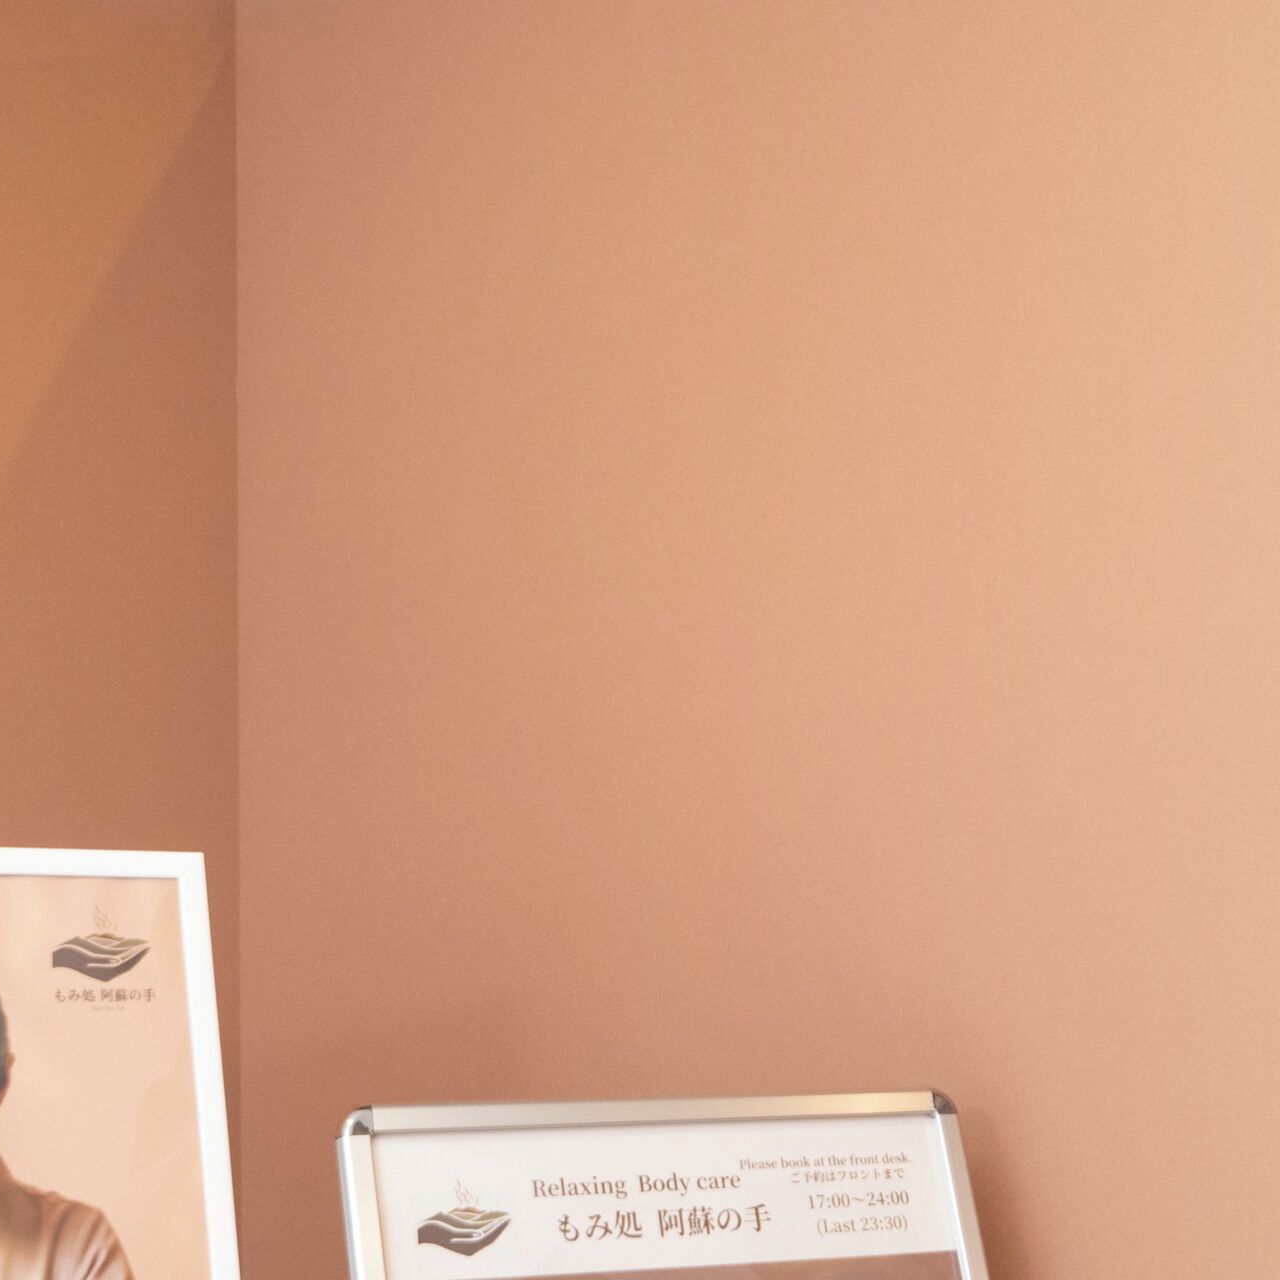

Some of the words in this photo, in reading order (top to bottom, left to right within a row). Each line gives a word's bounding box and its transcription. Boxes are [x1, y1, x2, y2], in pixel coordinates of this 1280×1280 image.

[739, 1158, 778, 1170] Please
[779, 1155, 811, 1169] book
[813, 1157, 825, 1167] at
[827, 1154, 847, 1167] the
[849, 1153, 879, 1166] front
[881, 1151, 912, 1164] desk.
[531, 1175, 628, 1200] Relaxing
[637, 1171, 690, 1197] Body
[696, 1174, 741, 1191] care
[557, 1209, 644, 1243] もみ処
[657, 1202, 772, 1239] 阿蘇の手
[816, 1218, 857, 1237] (Last
[859, 1214, 909, 1232] 23:30)
